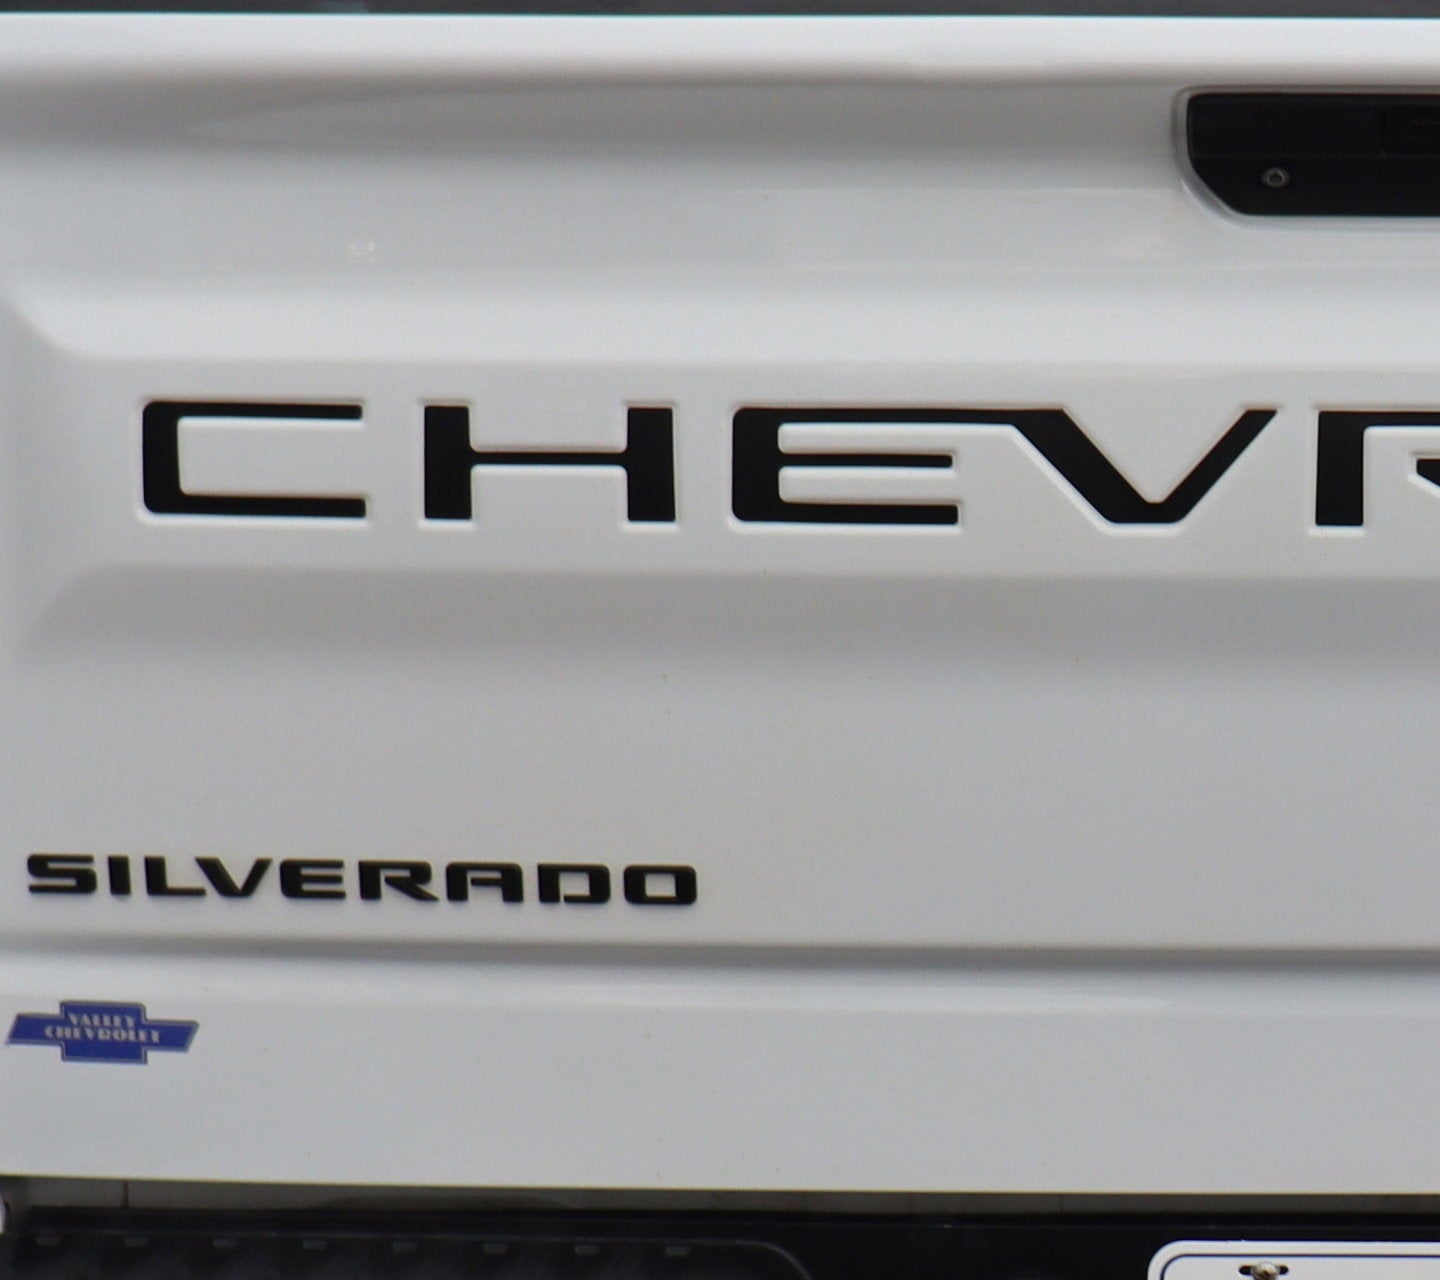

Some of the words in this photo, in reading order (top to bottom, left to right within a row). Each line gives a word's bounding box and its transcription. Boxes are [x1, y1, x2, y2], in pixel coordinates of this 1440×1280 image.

[27, 853, 698, 907] SILVERADO
[67, 1012, 135, 1028] VALLEY
[44, 1024, 160, 1044] CHEVROLET
